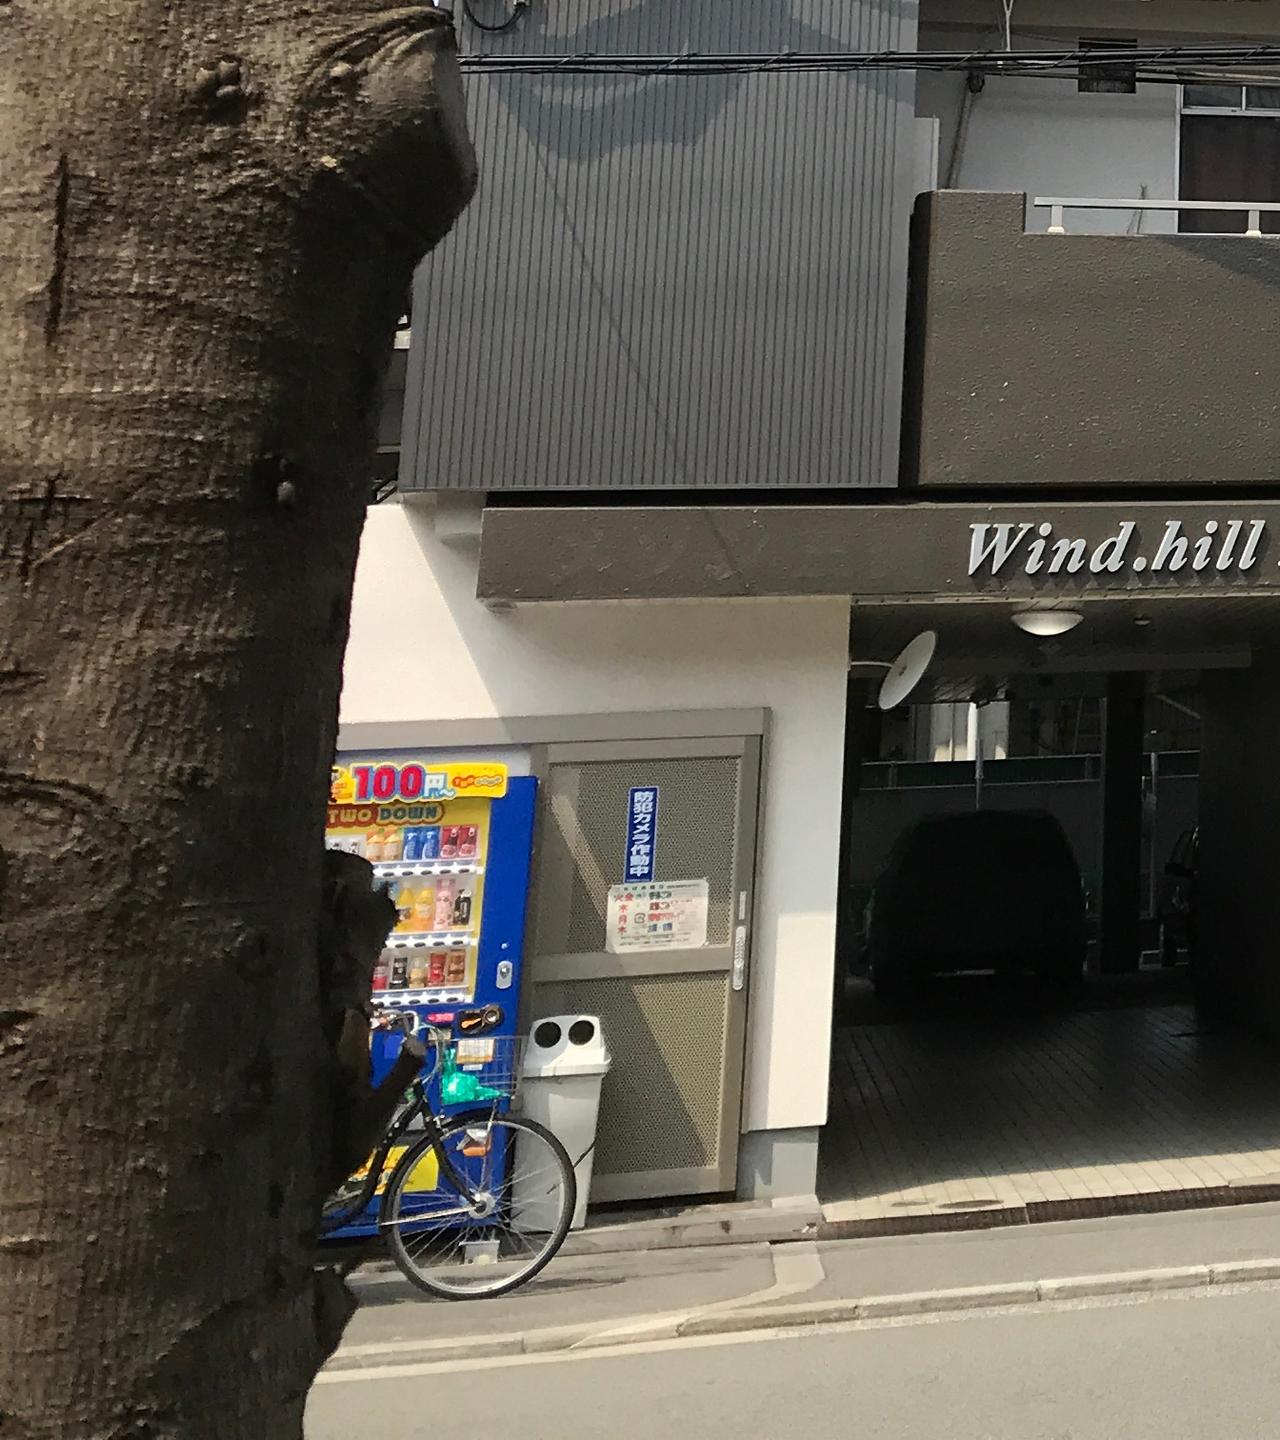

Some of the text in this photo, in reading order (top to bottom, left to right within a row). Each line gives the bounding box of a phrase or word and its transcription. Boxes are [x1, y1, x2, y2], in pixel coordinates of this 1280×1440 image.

[968, 520, 1266, 576] Wind.hill
[328, 806, 438, 823] TWO DOWN
[629, 791, 654, 877] 防犯カメラ作動中
